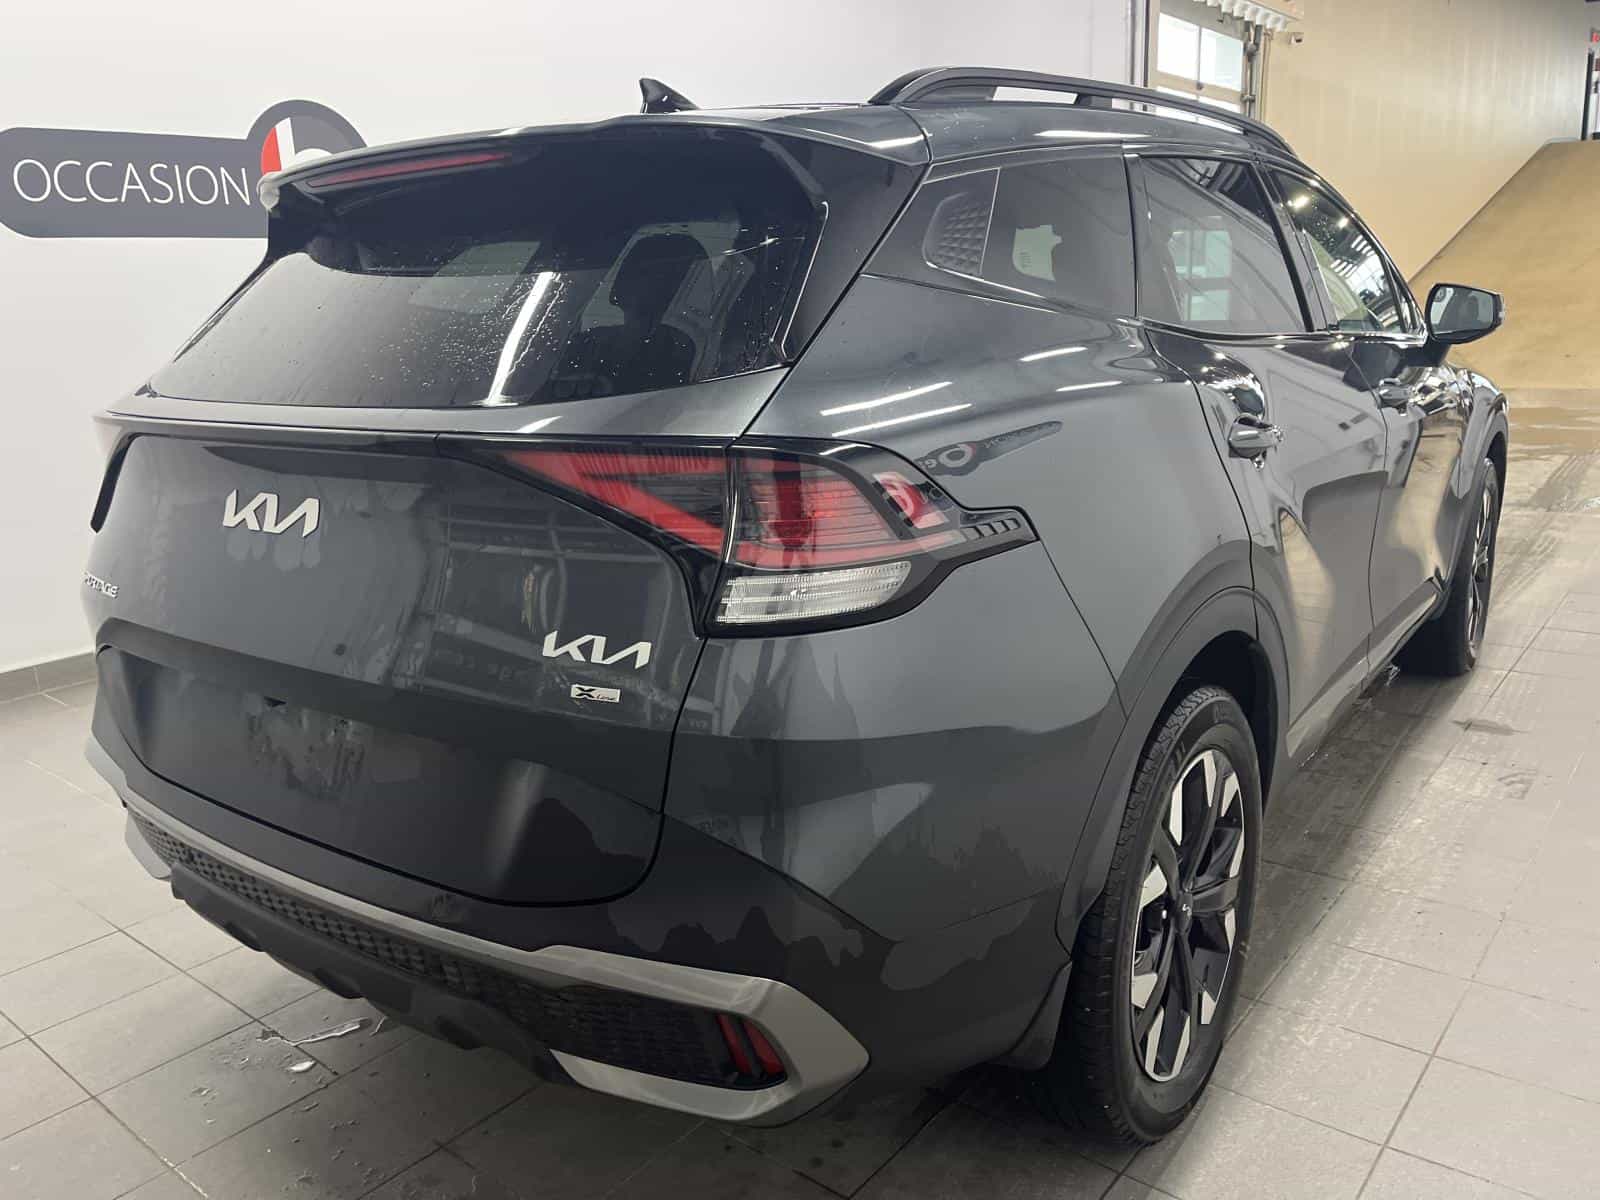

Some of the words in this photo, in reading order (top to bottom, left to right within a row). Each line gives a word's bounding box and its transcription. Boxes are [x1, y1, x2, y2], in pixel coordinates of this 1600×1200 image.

[13, 158, 251, 206] OCCASION
[222, 488, 320, 538] KIA
[542, 630, 652, 669] KIA
